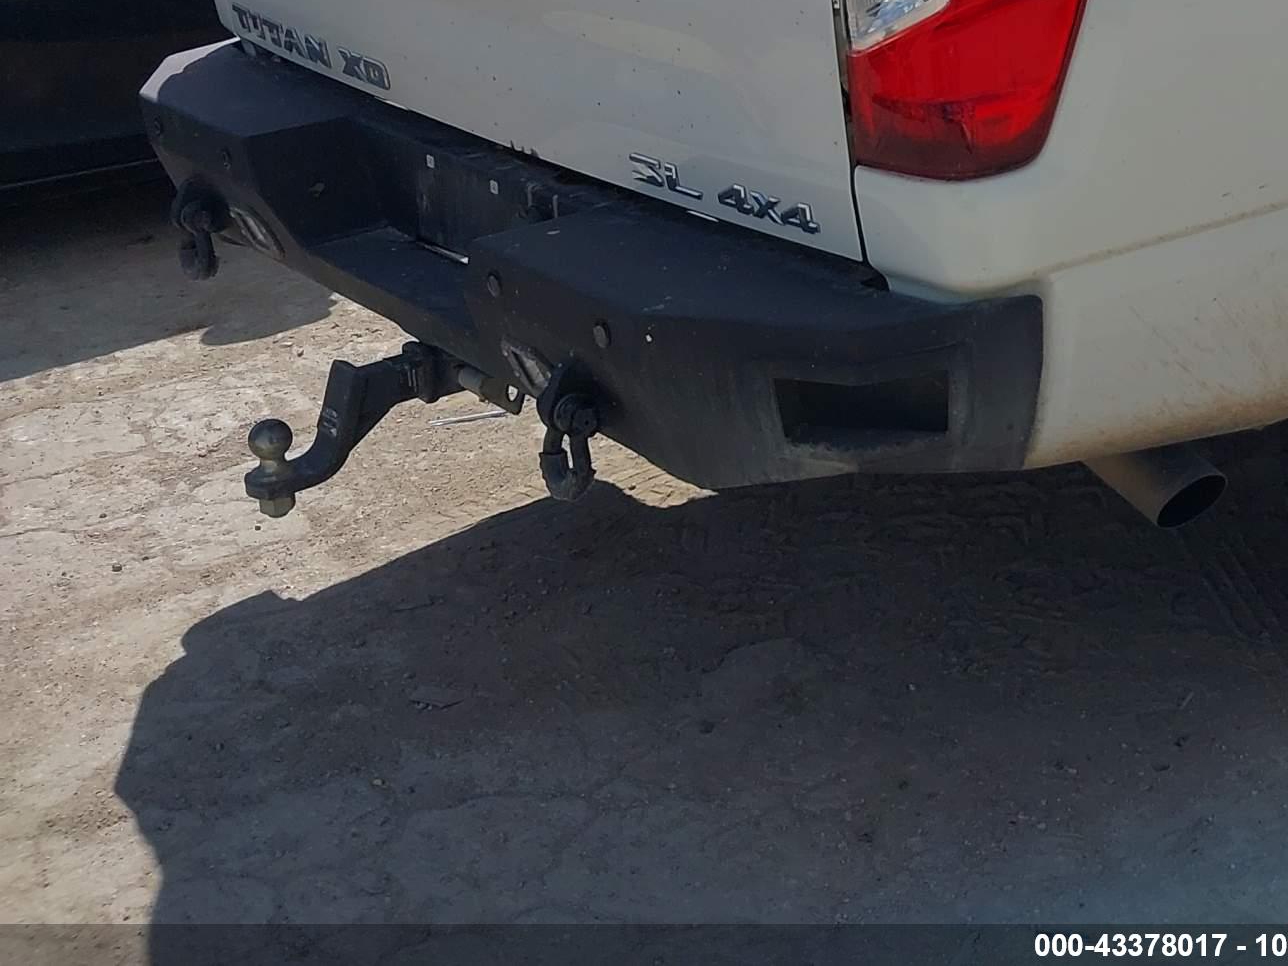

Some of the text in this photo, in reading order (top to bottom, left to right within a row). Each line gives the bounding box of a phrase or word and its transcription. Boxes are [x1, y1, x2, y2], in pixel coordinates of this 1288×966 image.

[232, 1, 391, 91] TITAN XD
[628, 152, 703, 200] SL
